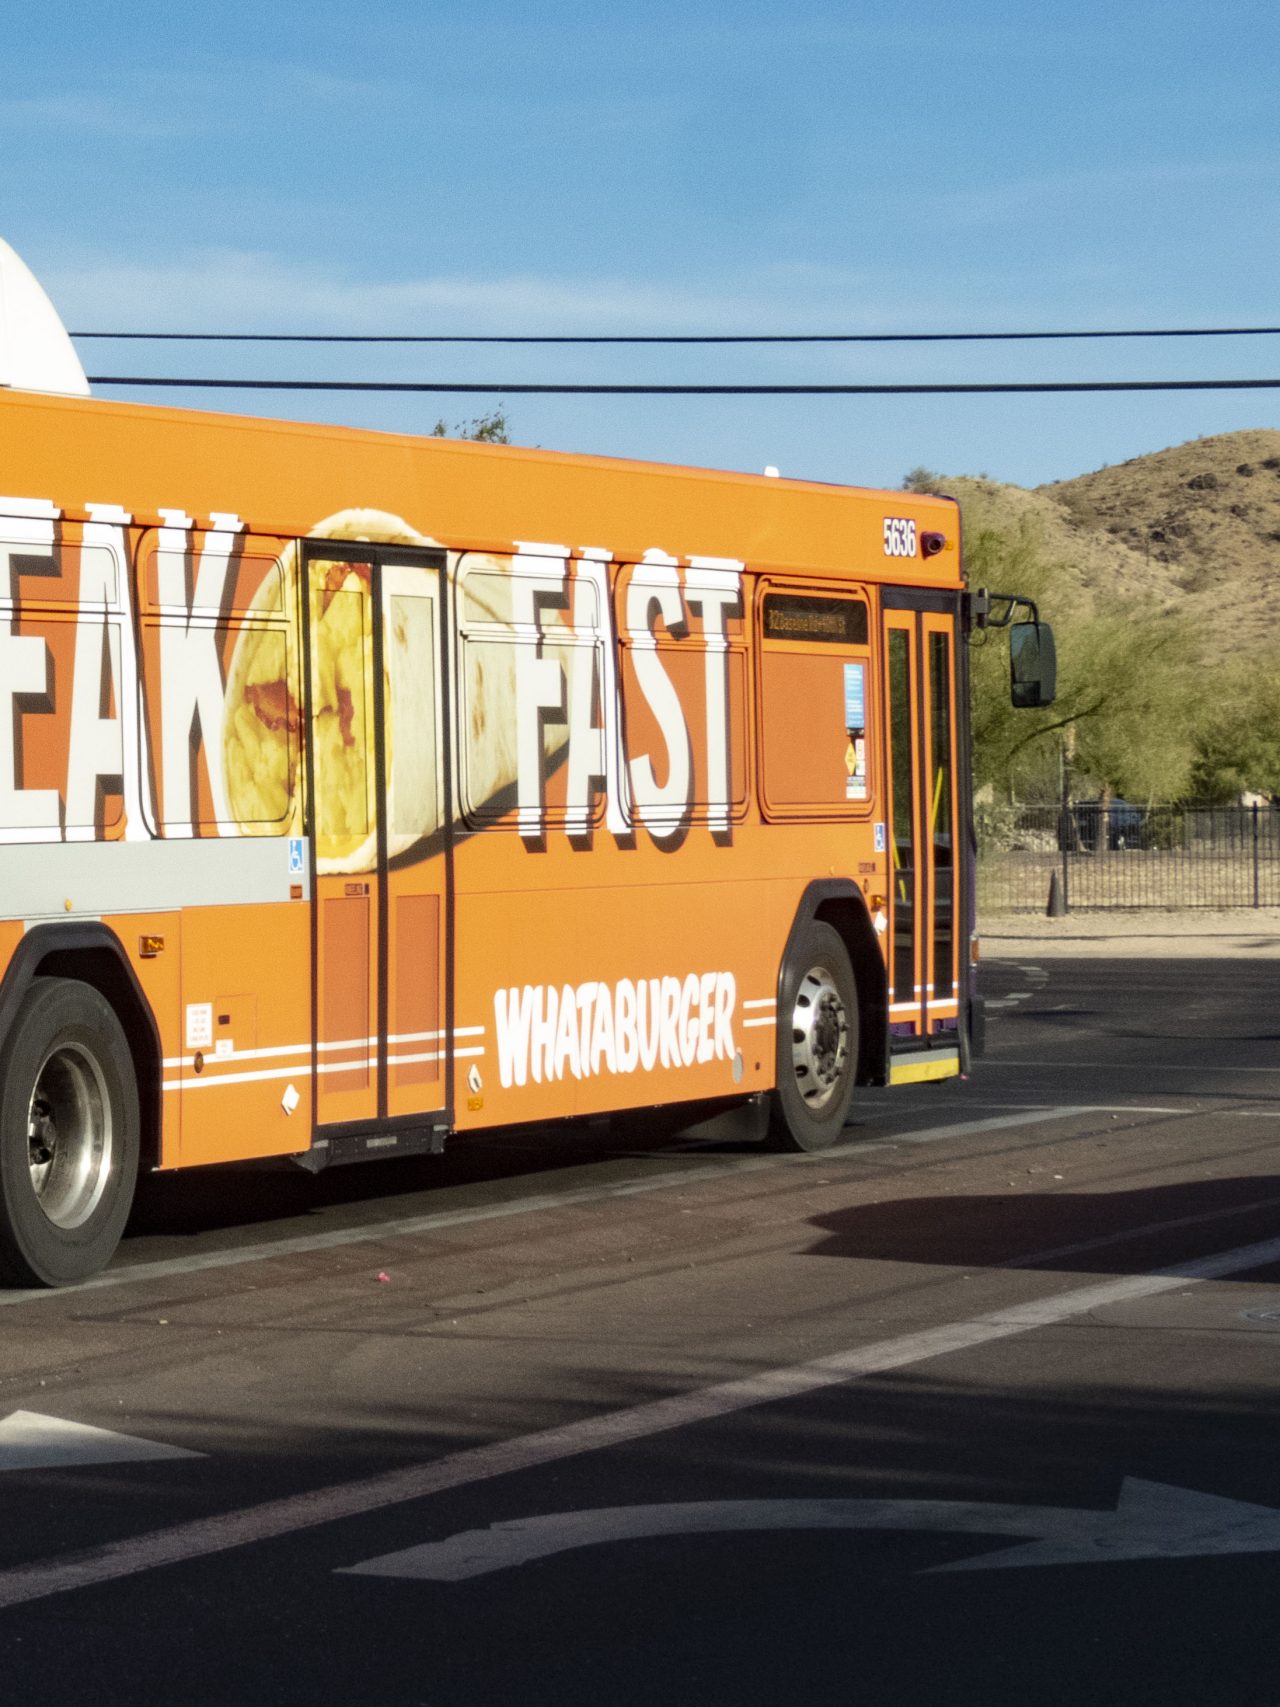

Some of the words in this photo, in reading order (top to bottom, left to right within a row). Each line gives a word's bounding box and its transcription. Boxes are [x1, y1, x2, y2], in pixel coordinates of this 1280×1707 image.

[883, 518, 916, 557] 5636
[513, 541, 746, 840] FAST
[494, 971, 736, 1088] WHATABURGER
